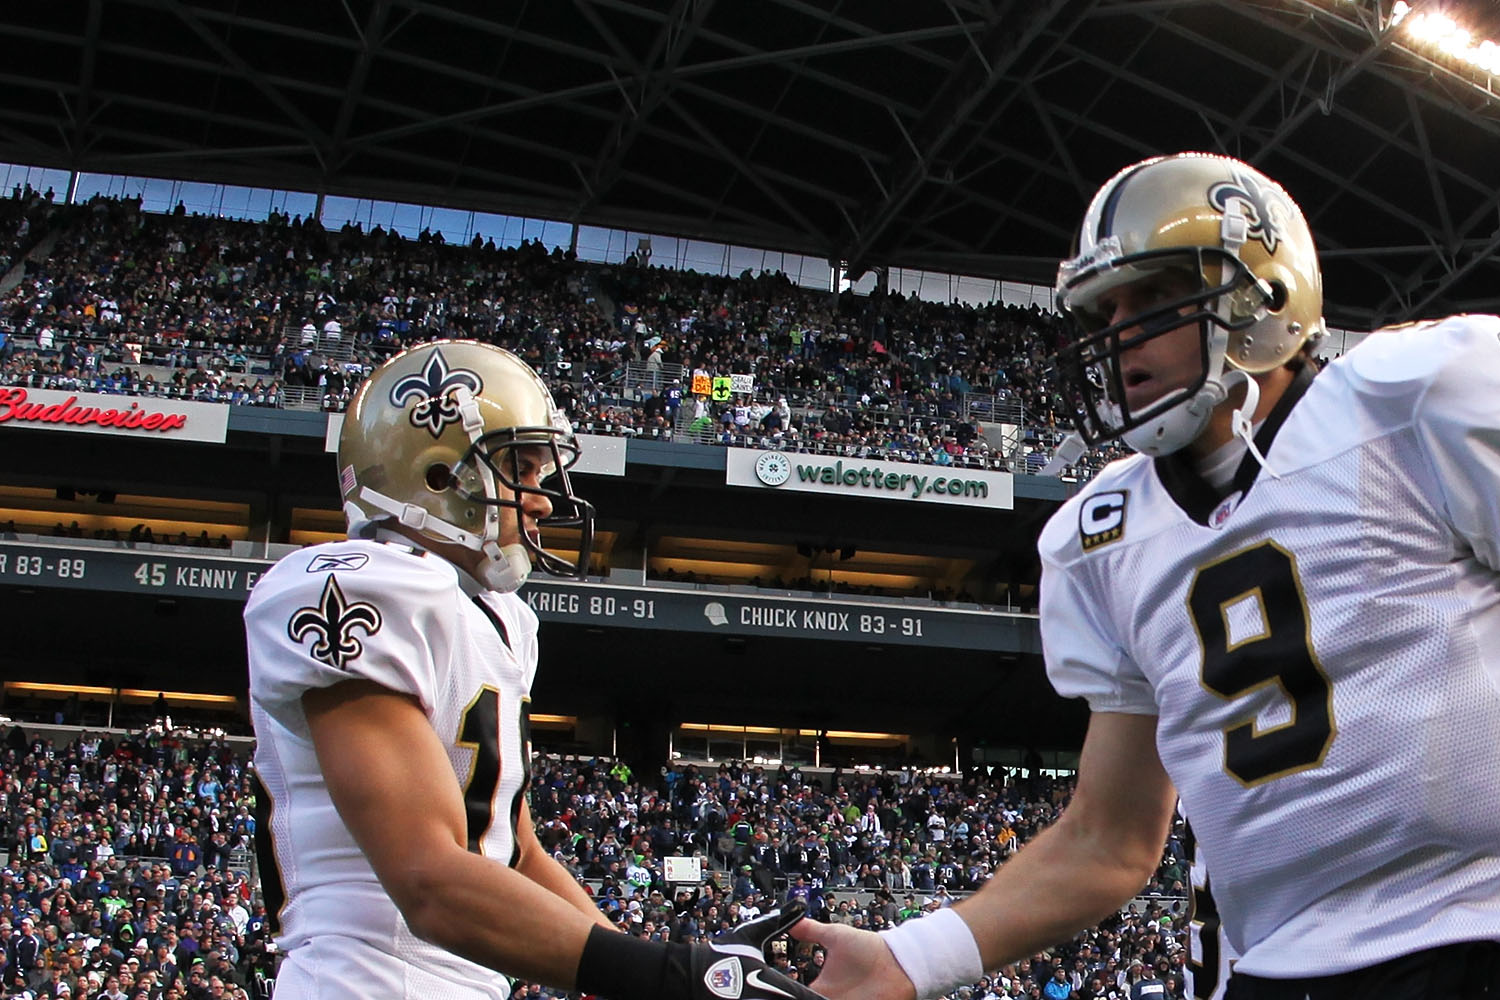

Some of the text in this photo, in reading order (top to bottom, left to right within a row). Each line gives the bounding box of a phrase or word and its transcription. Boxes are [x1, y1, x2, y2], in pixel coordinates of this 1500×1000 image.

[0, 387, 187, 433] Budweiser
[797, 460, 989, 499] walottery.com
[1080, 491, 1125, 537] C
[134, 562, 167, 587] 45
[176, 566, 238, 590] KENNY
[527, 591, 580, 616] KRIEG
[740, 606, 798, 631] CHUCK
[803, 609, 850, 634] KNOX
[1186, 538, 1337, 788] 9
[633, 871, 647, 882] 80
